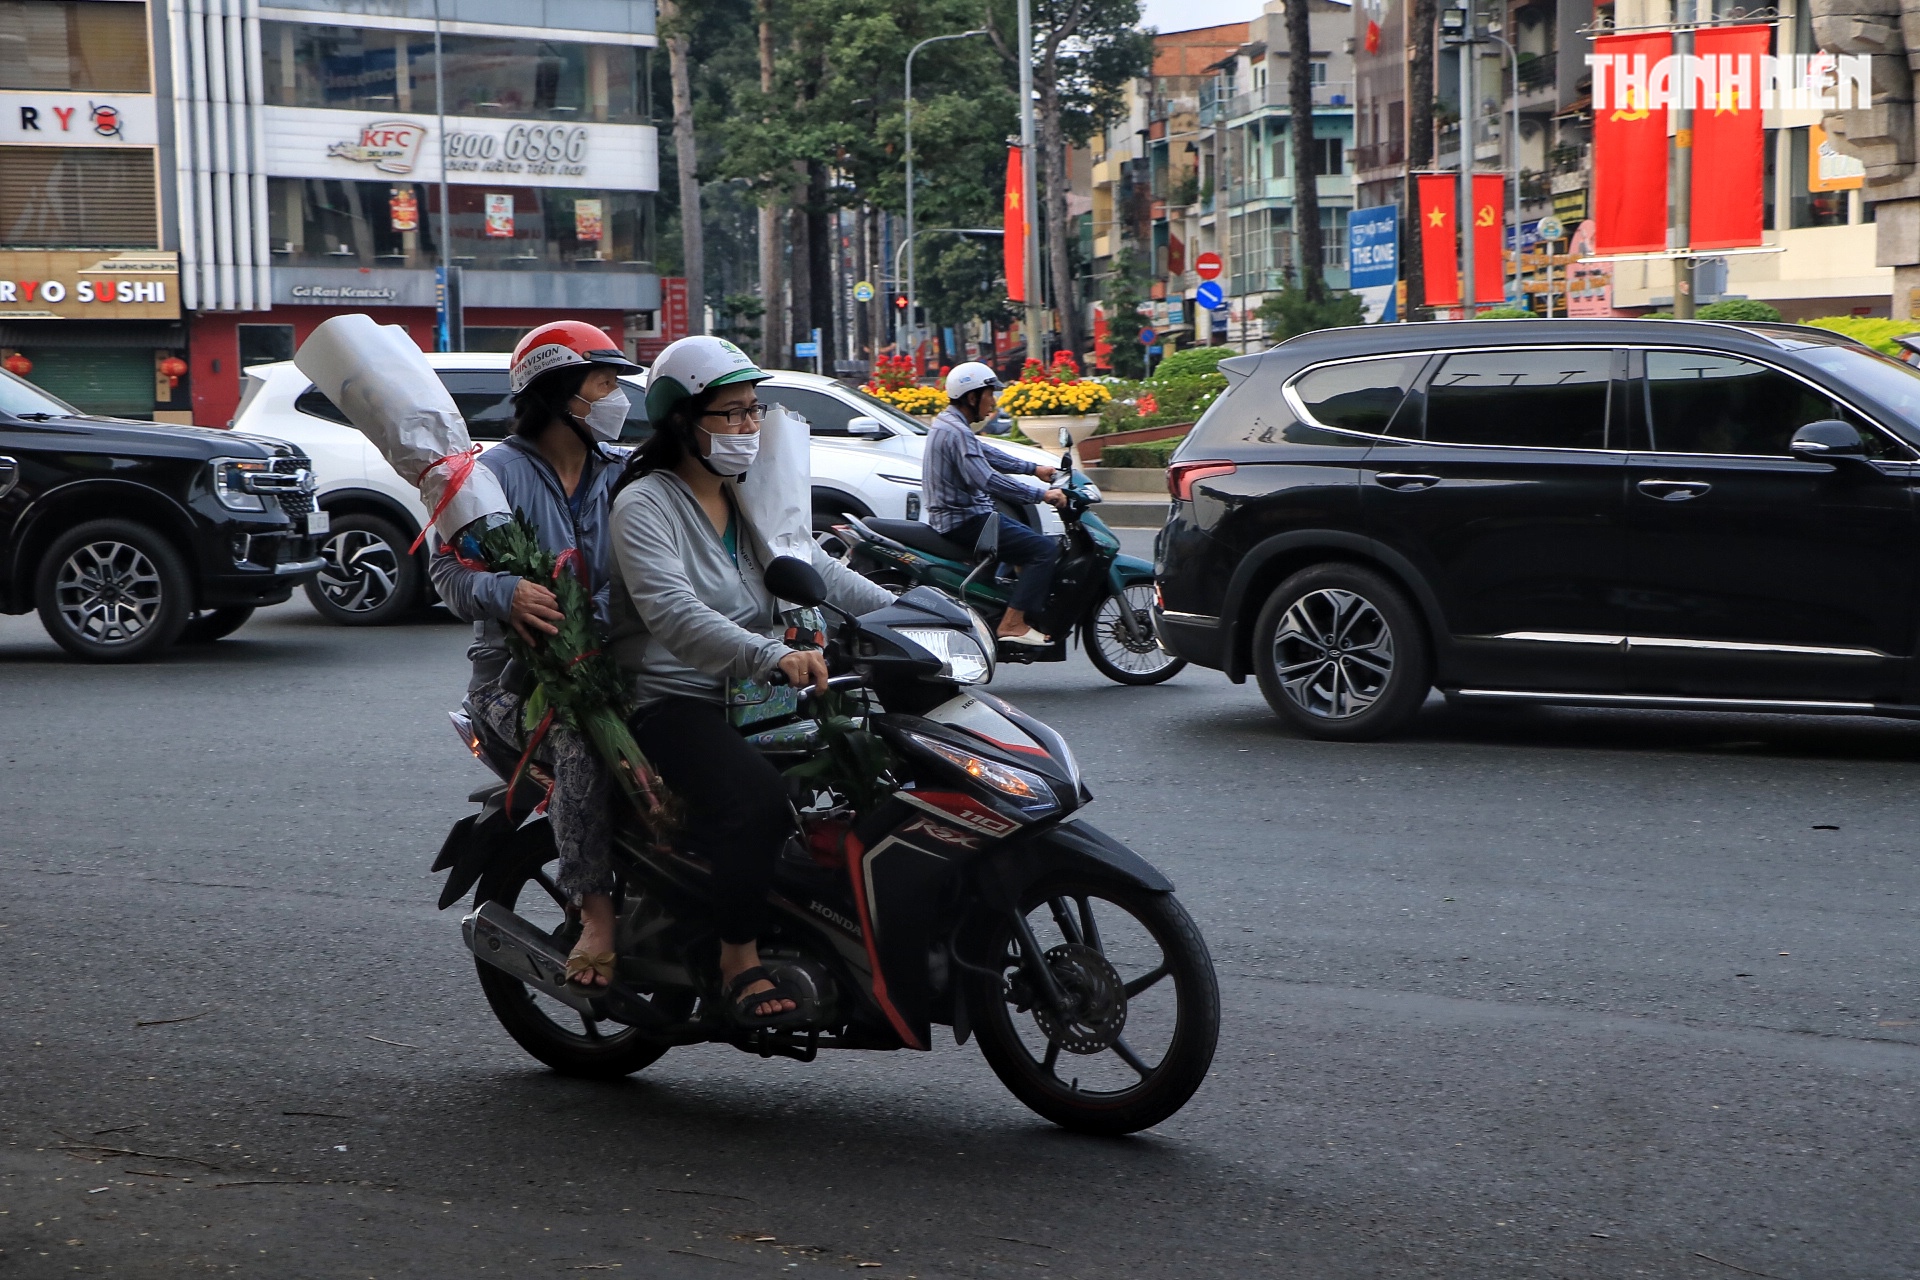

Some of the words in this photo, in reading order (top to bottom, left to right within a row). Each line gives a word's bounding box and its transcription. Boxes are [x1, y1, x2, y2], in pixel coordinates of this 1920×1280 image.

[361, 130, 411, 148] KFC
[444, 132, 497, 159] 1900
[504, 124, 587, 162] 6886
[1352, 245, 1372, 265] THE
[1373, 242, 1395, 262] ONE
[0, 281, 66, 303] RYO
[77, 281, 166, 303] SUSHI
[514, 346, 560, 377] HIKVISION
[542, 355, 563, 367] Further
[960, 809, 1010, 832] 110
[809, 900, 863, 937] HONDA
